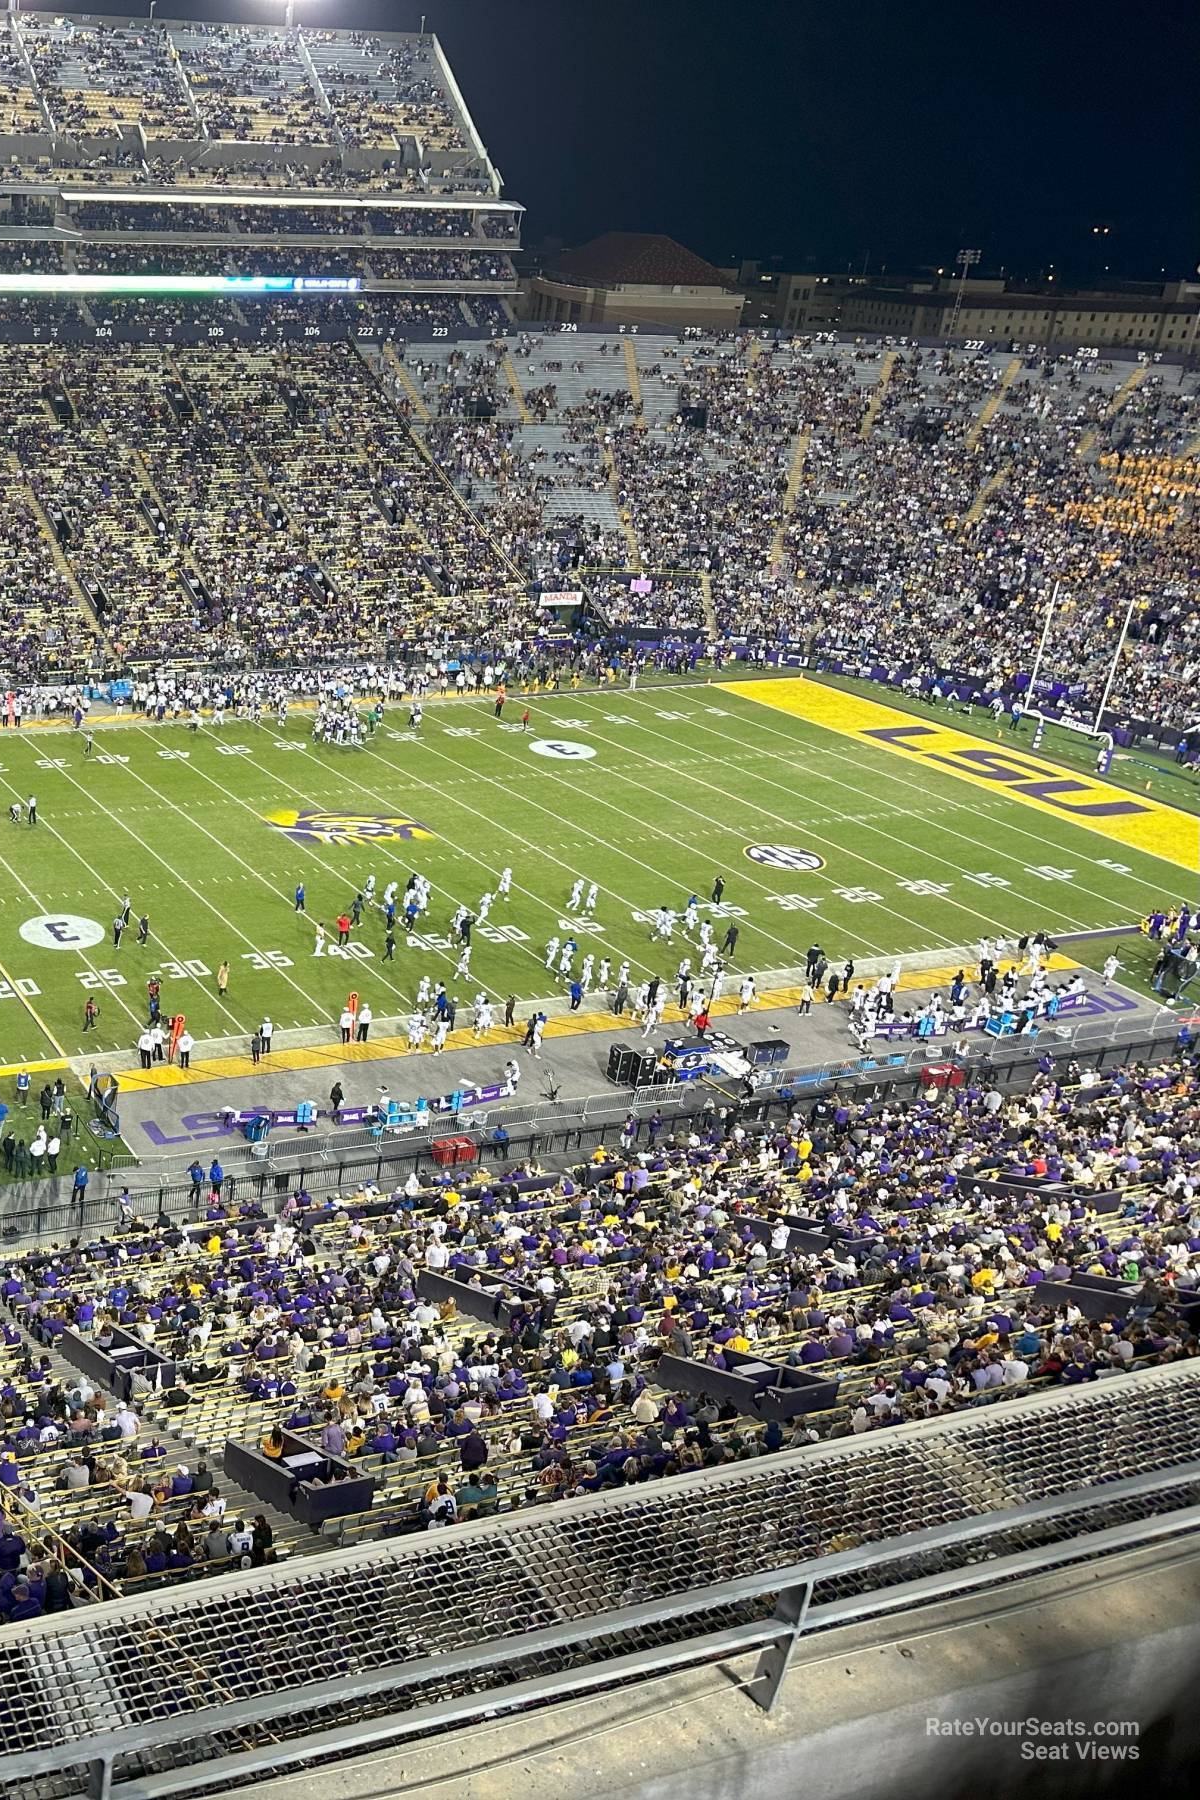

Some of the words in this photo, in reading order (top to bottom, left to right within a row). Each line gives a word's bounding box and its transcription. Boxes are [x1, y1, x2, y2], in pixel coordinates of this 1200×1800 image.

[95, 327, 113, 337] 104
[207, 327, 224, 336] 105
[304, 327, 321, 336] 106
[357, 327, 373, 336] 222
[432, 327, 448, 337] 223
[560, 323, 577, 332] 224
[964, 340, 984, 350] 227
[544, 593, 577, 602] MANDA
[655, 711, 691, 720] 10
[705, 708, 730, 716] 5
[603, 715, 639, 724] 15
[385, 731, 424, 741] 35
[442, 728, 477, 737] 30
[214, 745, 254, 756] 50
[274, 741, 307, 751] 45
[96, 755, 131, 766] 40
[156, 750, 190, 761] 45
[34, 759, 73, 769] 35
[859, 725, 1156, 817] LSU
[1096, 858, 1133, 873] 5
[1023, 865, 1072, 880] 10
[962, 873, 1012, 888] 15
[896, 880, 947, 896] 20
[831, 887, 884, 903] 25
[764, 895, 819, 912] 30
[701, 901, 749, 919] 35
[557, 916, 606, 934] 45
[475, 924, 532, 943] 50
[406, 933, 453, 952] 45
[324, 941, 376, 961] 40
[240, 950, 296, 971] 35
[159, 959, 213, 979] 30
[74, 968, 129, 989] 25
